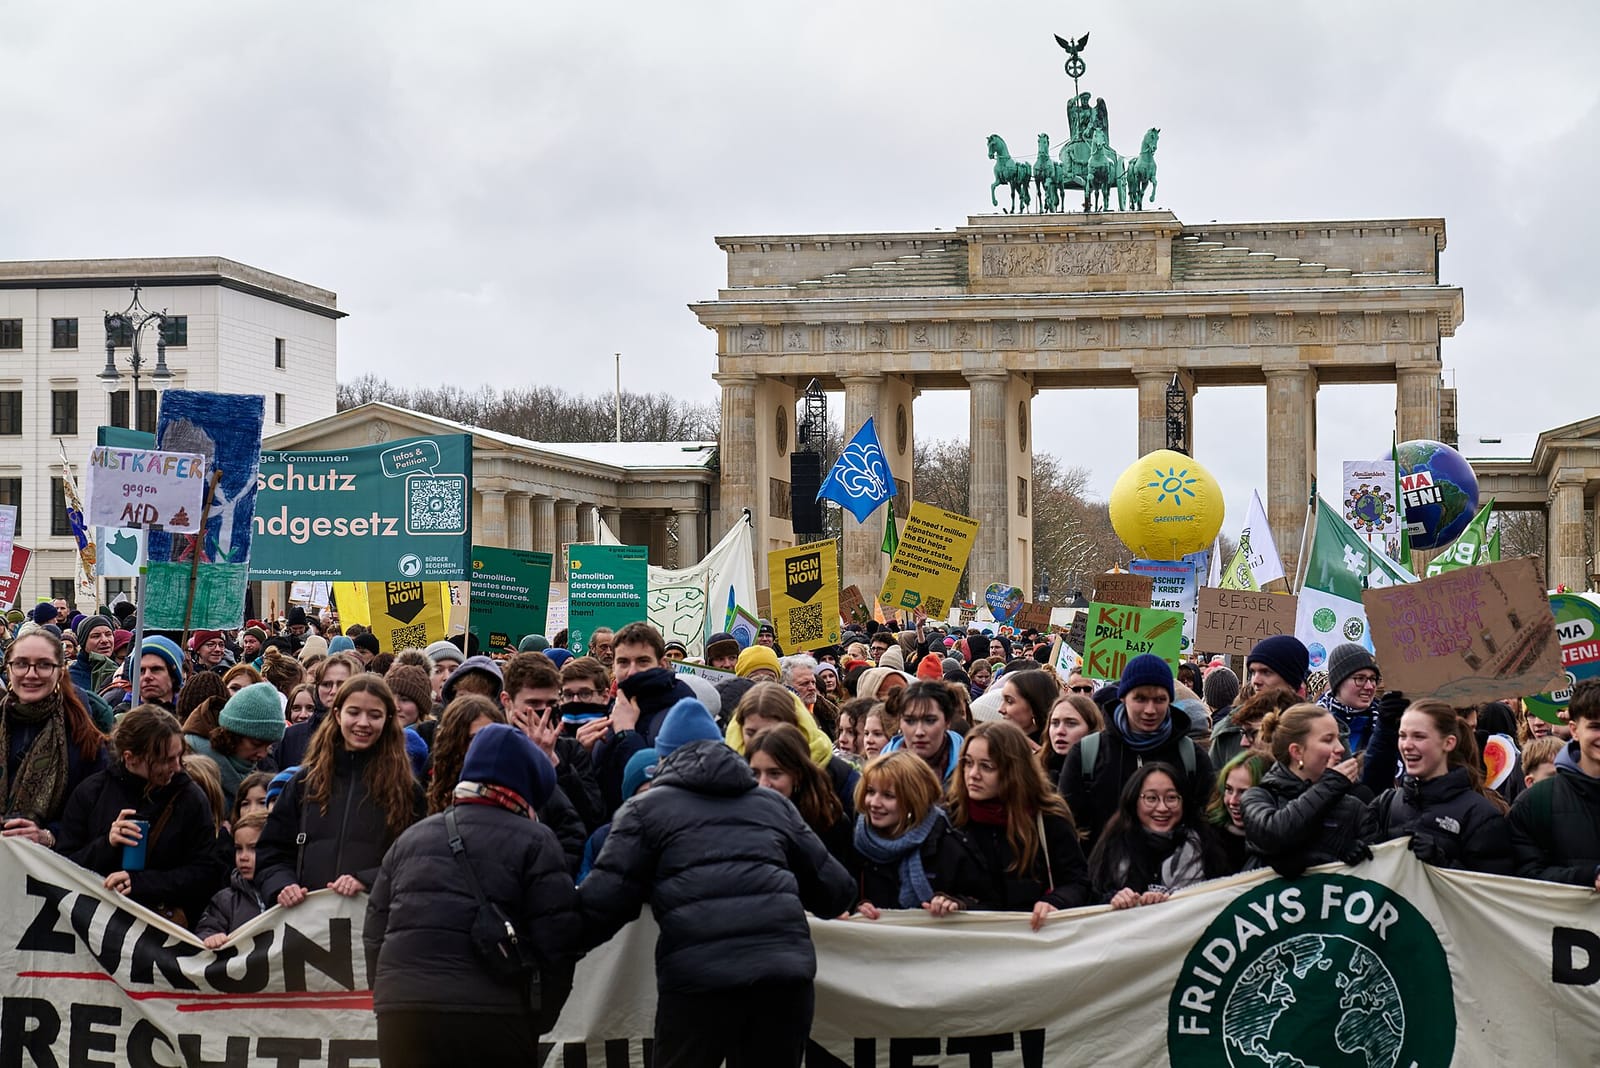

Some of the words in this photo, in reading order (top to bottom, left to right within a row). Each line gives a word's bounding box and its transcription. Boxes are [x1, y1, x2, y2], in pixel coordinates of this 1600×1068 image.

[91, 448, 202, 479] MISTKÄFER
[280, 453, 349, 462] Kommunen
[393, 450, 414, 462] Infos
[395, 456, 428, 469] Petition
[257, 464, 356, 491] schutz
[122, 483, 158, 498] gegen
[120, 502, 159, 524] AfD
[944, 512, 959, 520] HOUSE
[252, 505, 400, 544] ndgesetz
[906, 525, 944, 540] signatures
[910, 516, 920, 524] We
[922, 520, 939, 530] need
[944, 527, 967, 539] million
[904, 532, 916, 541] the
[917, 536, 927, 544] EU
[928, 538, 946, 551] helps
[901, 542, 930, 554] member
[931, 550, 953, 562] states
[788, 558, 819, 574] SIGN
[895, 558, 908, 566] and
[909, 562, 940, 576] renovate
[906, 552, 922, 562] stop
[924, 556, 960, 573] demolition
[472, 572, 516, 582] Demolition
[789, 569, 819, 585] NOW
[892, 565, 920, 578] Europe!
[388, 581, 420, 592] SIGN
[571, 582, 606, 591] destroys
[1096, 580, 1125, 591] DIESES
[1154, 577, 1186, 585] ASCHUTZ
[390, 587, 421, 605] NOW
[487, 592, 530, 602] resources.
[501, 585, 529, 594] energy
[986, 594, 1004, 602] omas
[991, 600, 1010, 609] future
[1219, 593, 1276, 612] BESSER
[1098, 607, 1141, 633] Kill
[1204, 611, 1249, 631] JETZT
[1254, 618, 1283, 636] ALS
[1095, 625, 1123, 639] DRILL
[1392, 627, 1416, 646] NO
[1556, 624, 1585, 640] MA
[1126, 640, 1154, 653] BABY
[1404, 646, 1422, 663] IN
[1428, 632, 1472, 656] 2025
[1562, 644, 1598, 663] TEN!
[1088, 648, 1127, 679] Kill
[1178, 888, 1306, 1036] FRIDAYS
[1320, 884, 1399, 940] FOR
